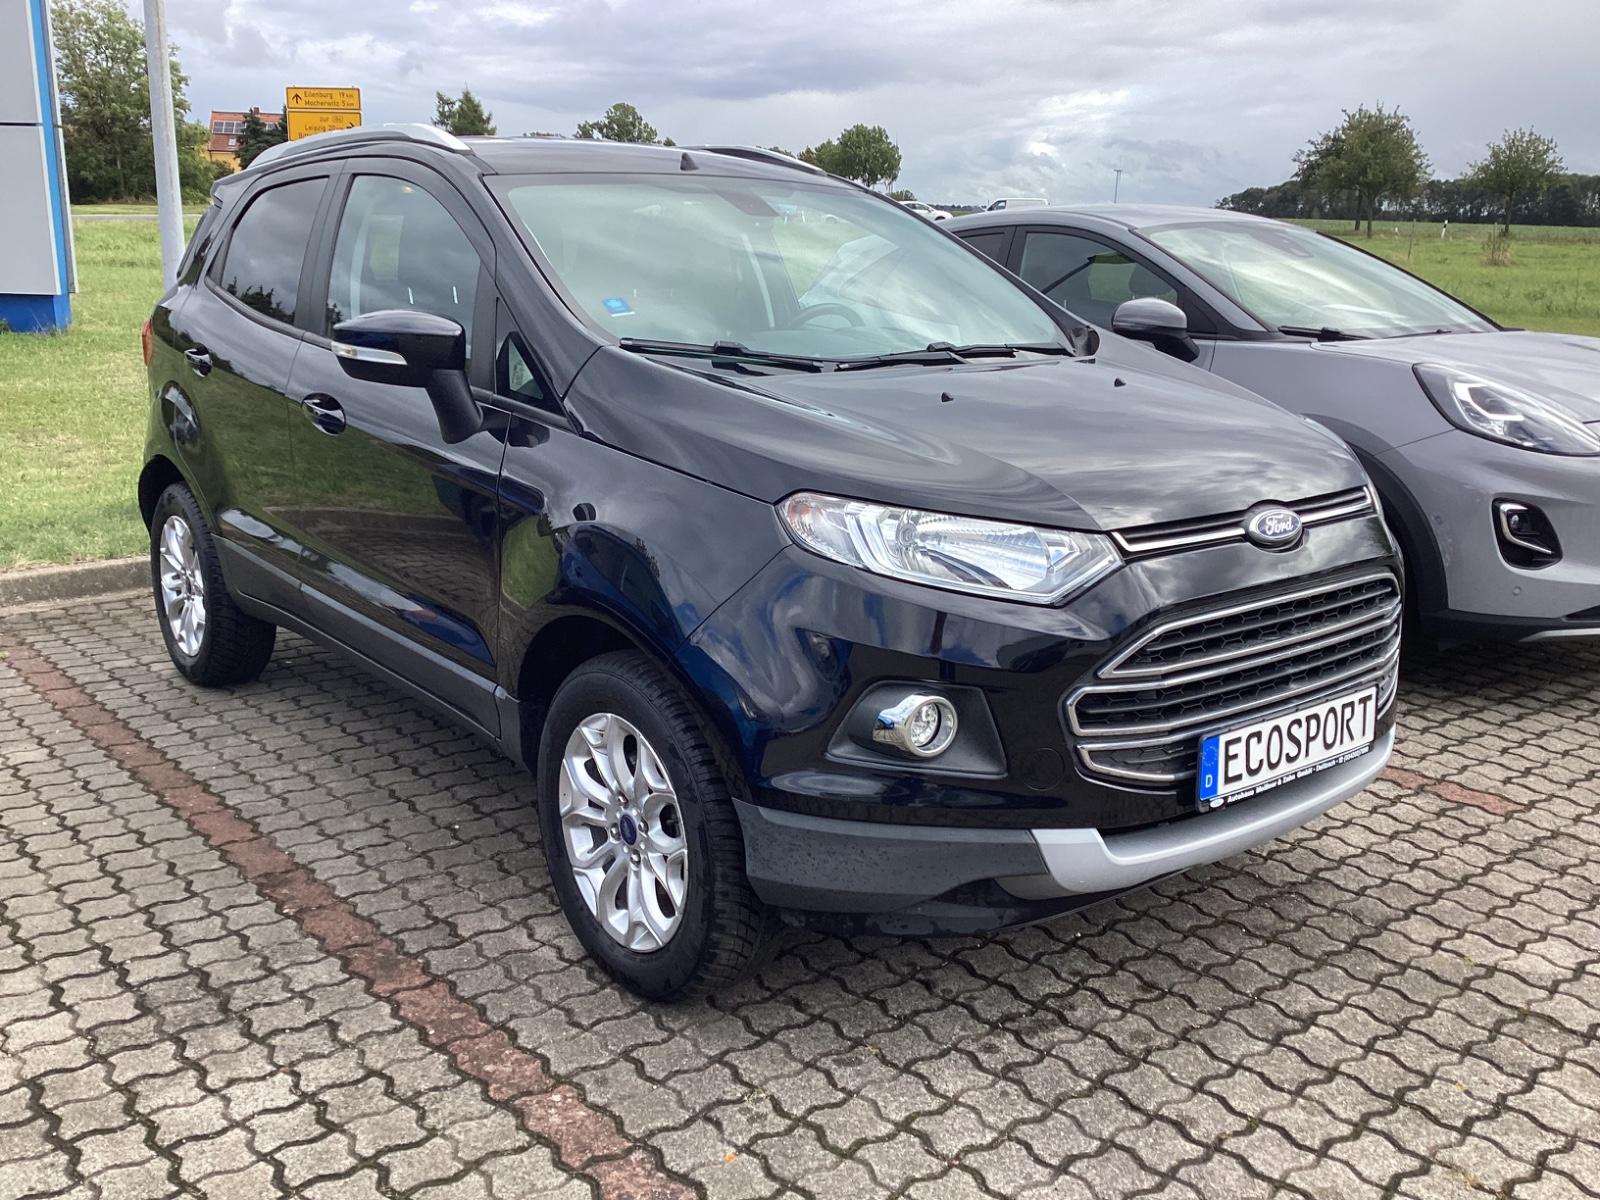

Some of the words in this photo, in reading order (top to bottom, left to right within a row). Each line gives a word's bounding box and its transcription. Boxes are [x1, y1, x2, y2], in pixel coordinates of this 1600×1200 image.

[1265, 513, 1294, 535] Ford
[1223, 694, 1373, 785] ECOSPORT
[1205, 774, 1213, 788] D
